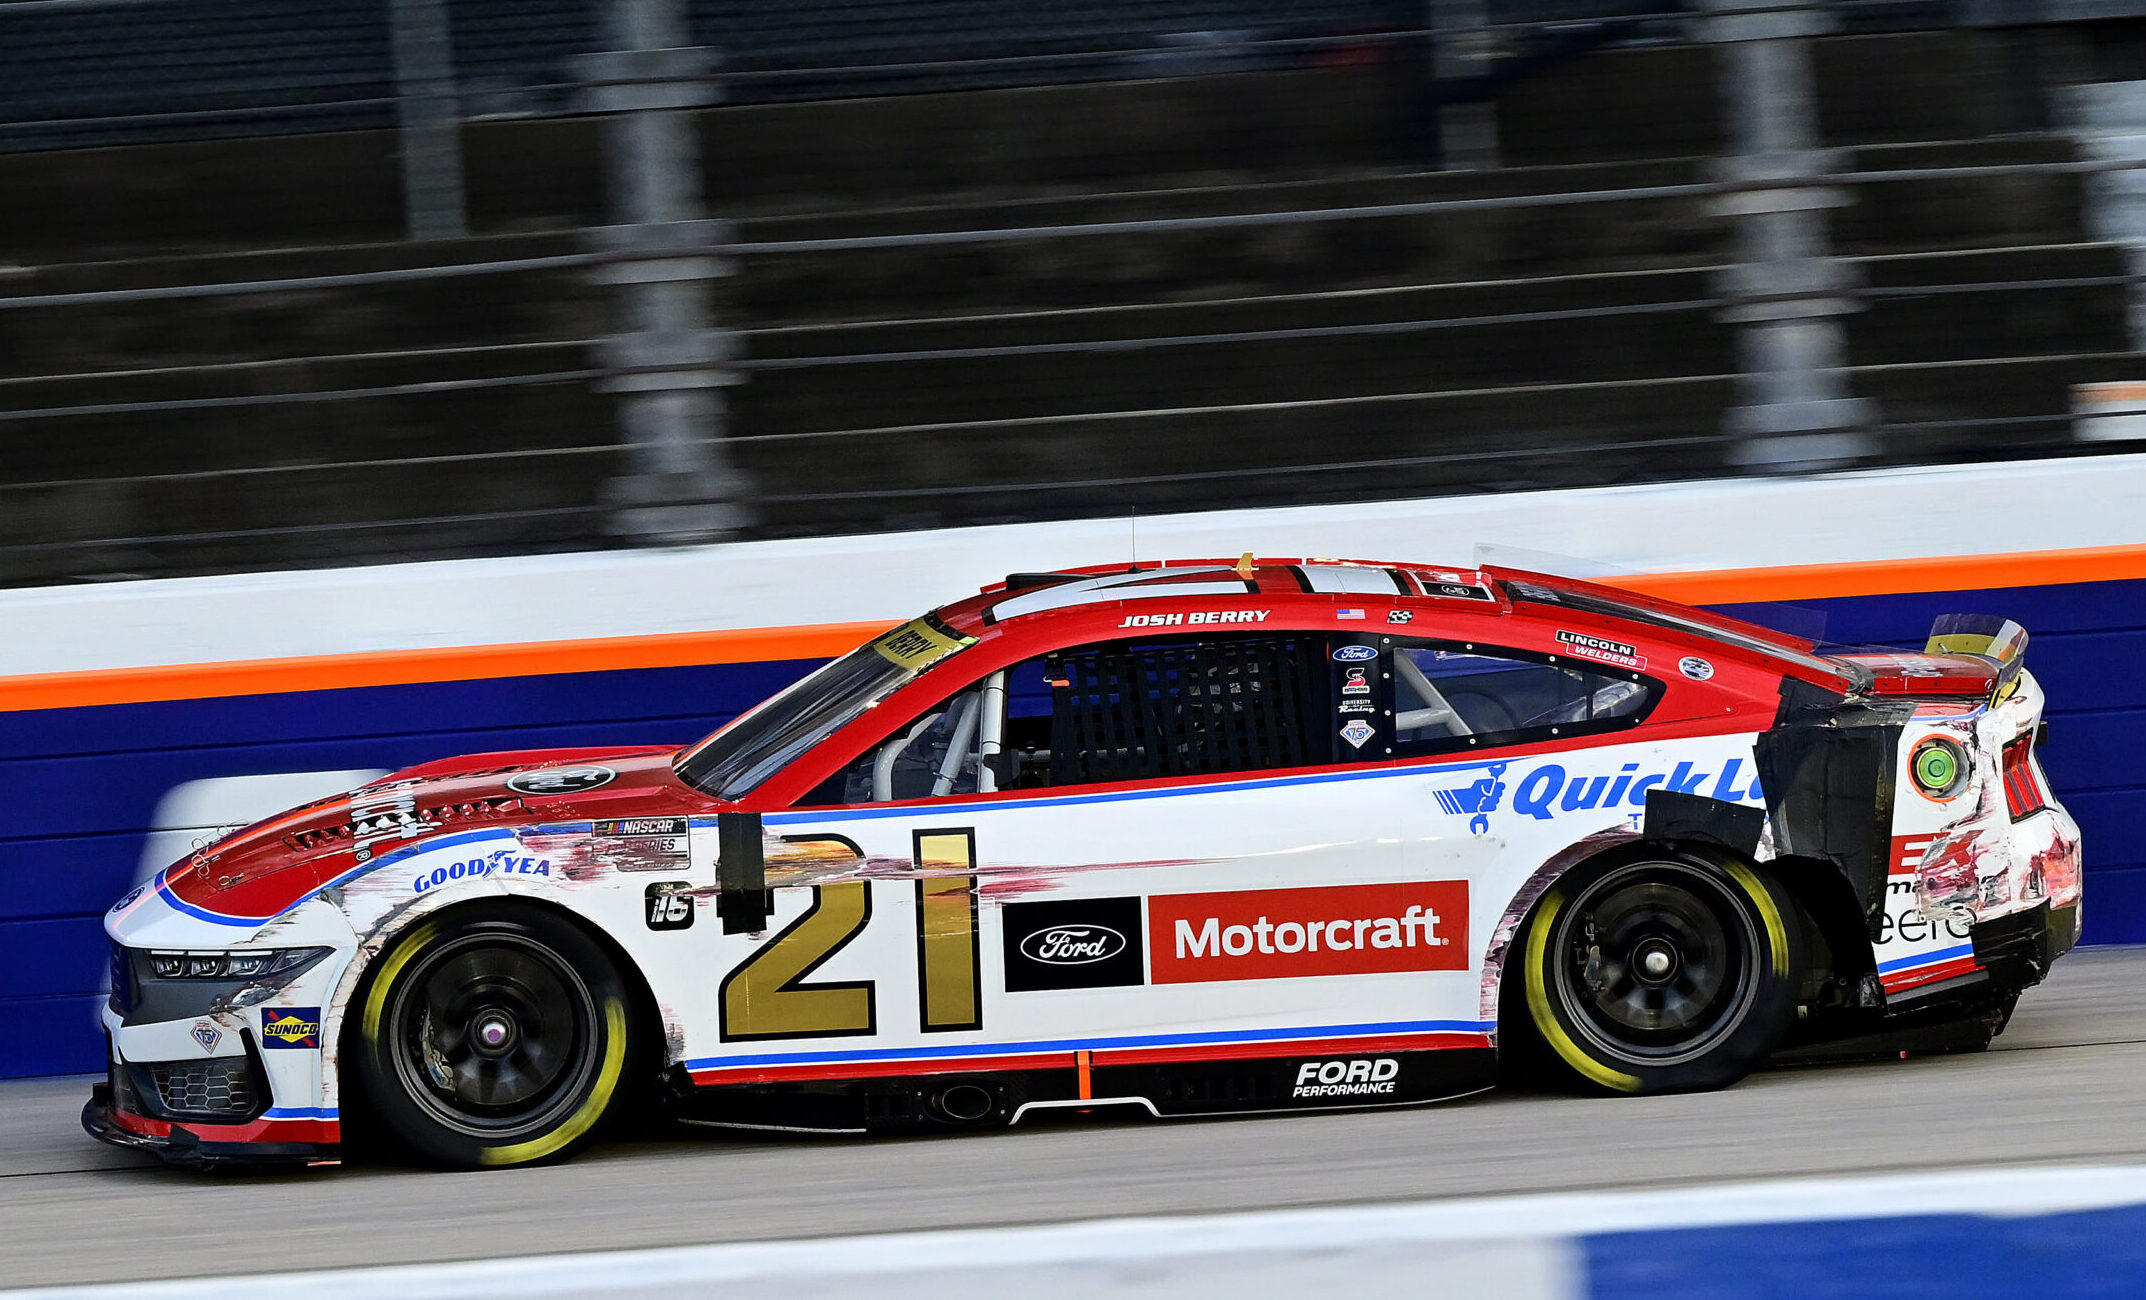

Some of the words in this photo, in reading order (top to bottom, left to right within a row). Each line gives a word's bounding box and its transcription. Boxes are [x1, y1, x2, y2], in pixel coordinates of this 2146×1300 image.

[1117, 613, 1184, 628] JOSH
[1187, 609, 1271, 625] BERRY
[1340, 647, 1370, 659] Ford
[1560, 632, 1631, 655] LINCOLN
[1574, 645, 1638, 667] WELDERS
[623, 819, 674, 833] NASCAR
[717, 826, 983, 1043] 21
[1039, 930, 1107, 958] Ford
[265, 1023, 318, 1036] SUNOCO
[1295, 1058, 1399, 1086] FORD
[1292, 1081, 1396, 1098] PERFORMANCE
